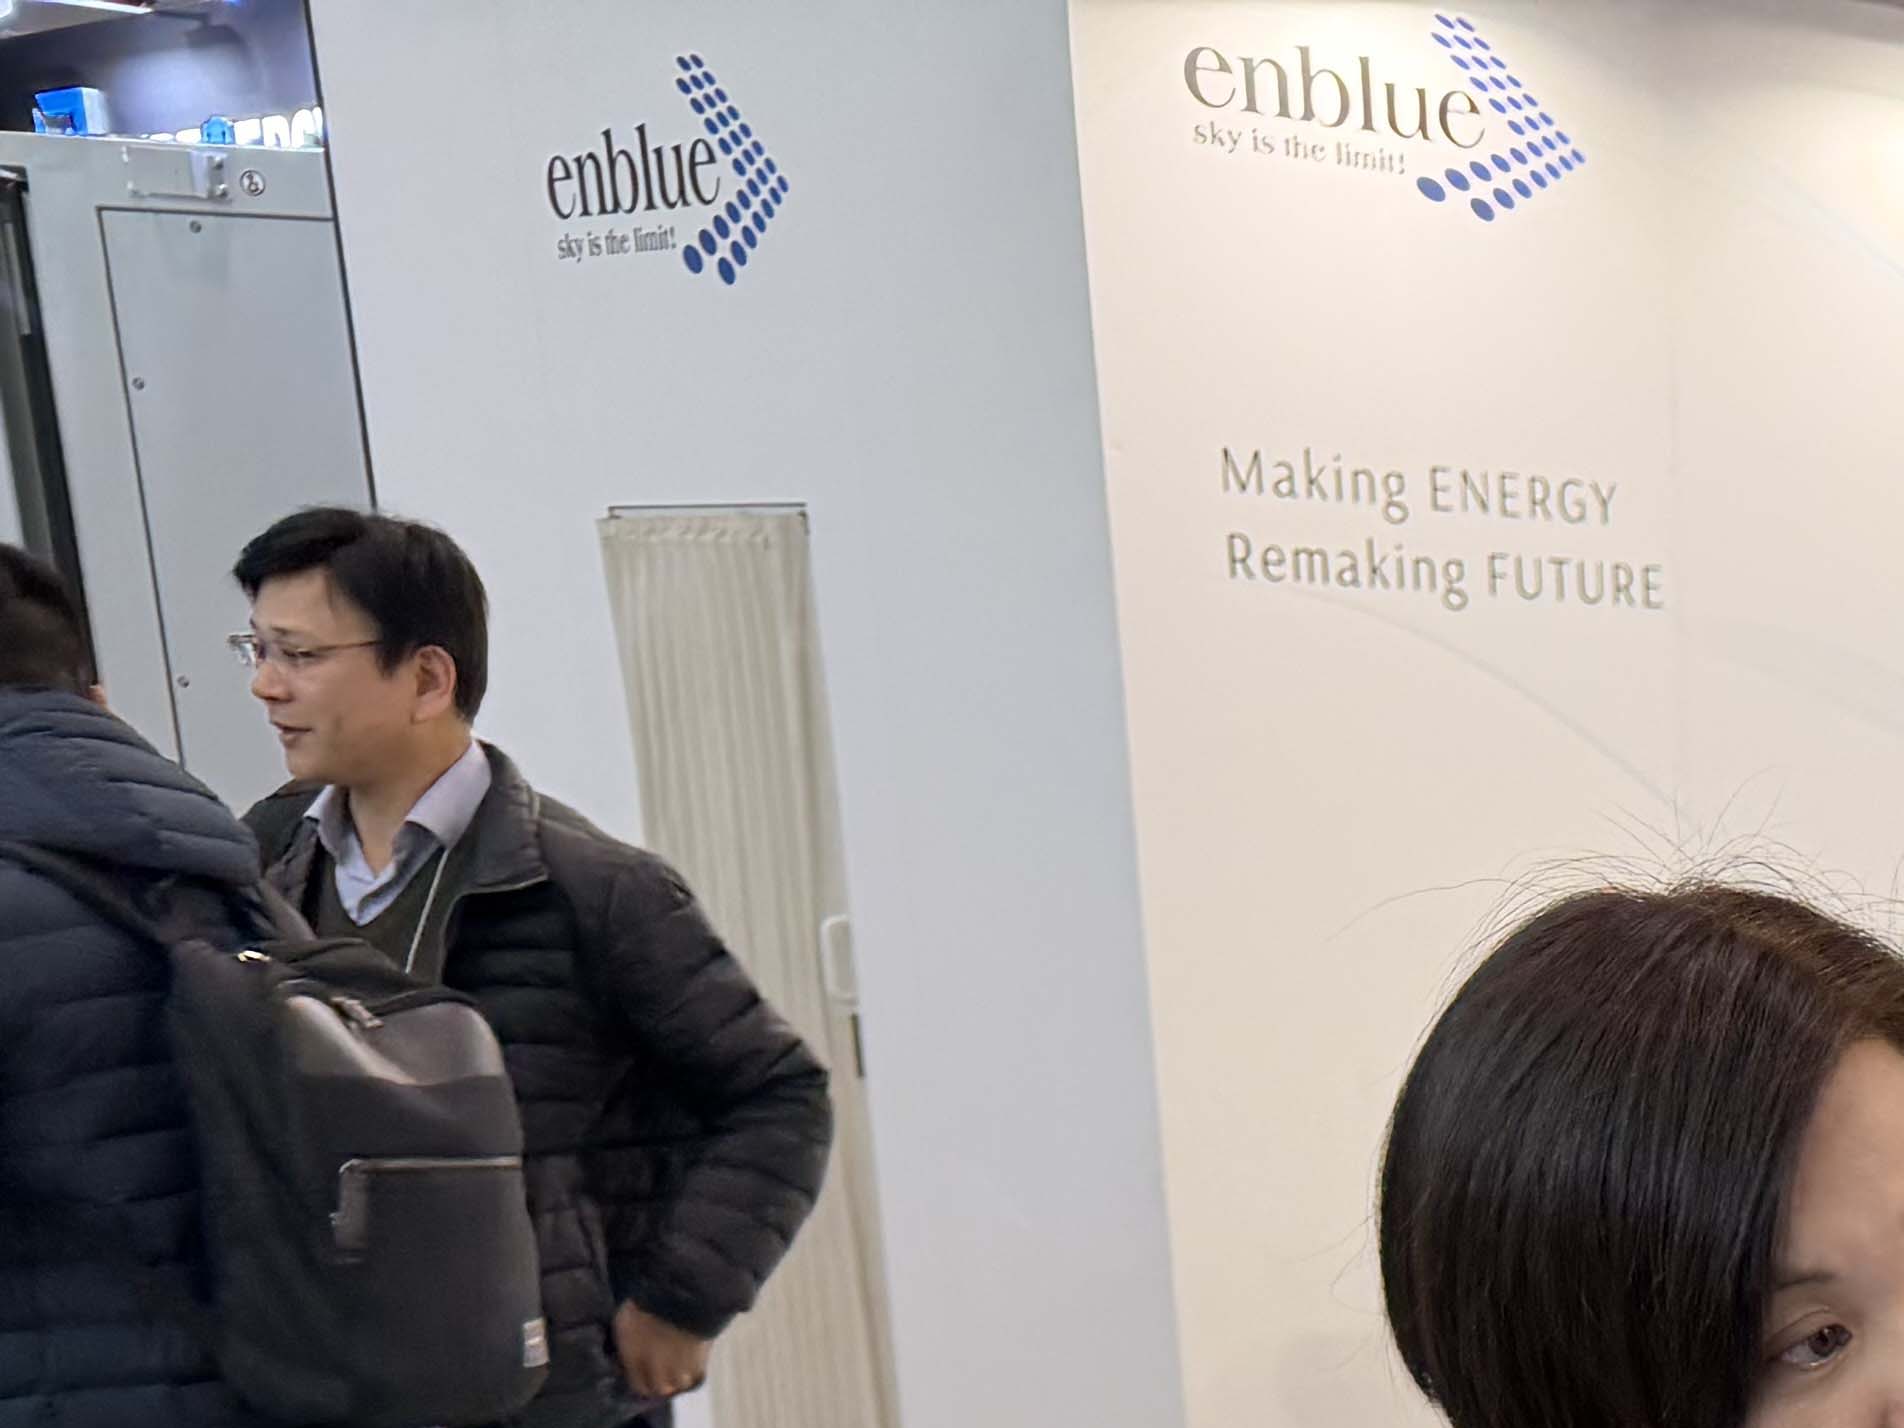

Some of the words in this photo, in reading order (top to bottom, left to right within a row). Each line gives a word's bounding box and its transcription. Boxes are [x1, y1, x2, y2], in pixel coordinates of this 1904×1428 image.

[1183, 45, 1486, 149] enblue
[546, 122, 720, 220] enblue
[1193, 120, 1243, 154] sky
[1252, 127, 1276, 155] is
[1284, 135, 1327, 162] the
[1335, 142, 1406, 175] limit!
[557, 232, 584, 262] sky
[587, 231, 601, 255] is
[604, 228, 631, 253] the
[633, 224, 678, 252] limit!
[1220, 446, 1411, 526] Making
[1429, 464, 1618, 527] ENERGY
[1226, 530, 1470, 612] Remaking
[1487, 552, 1665, 611] FUTURE
